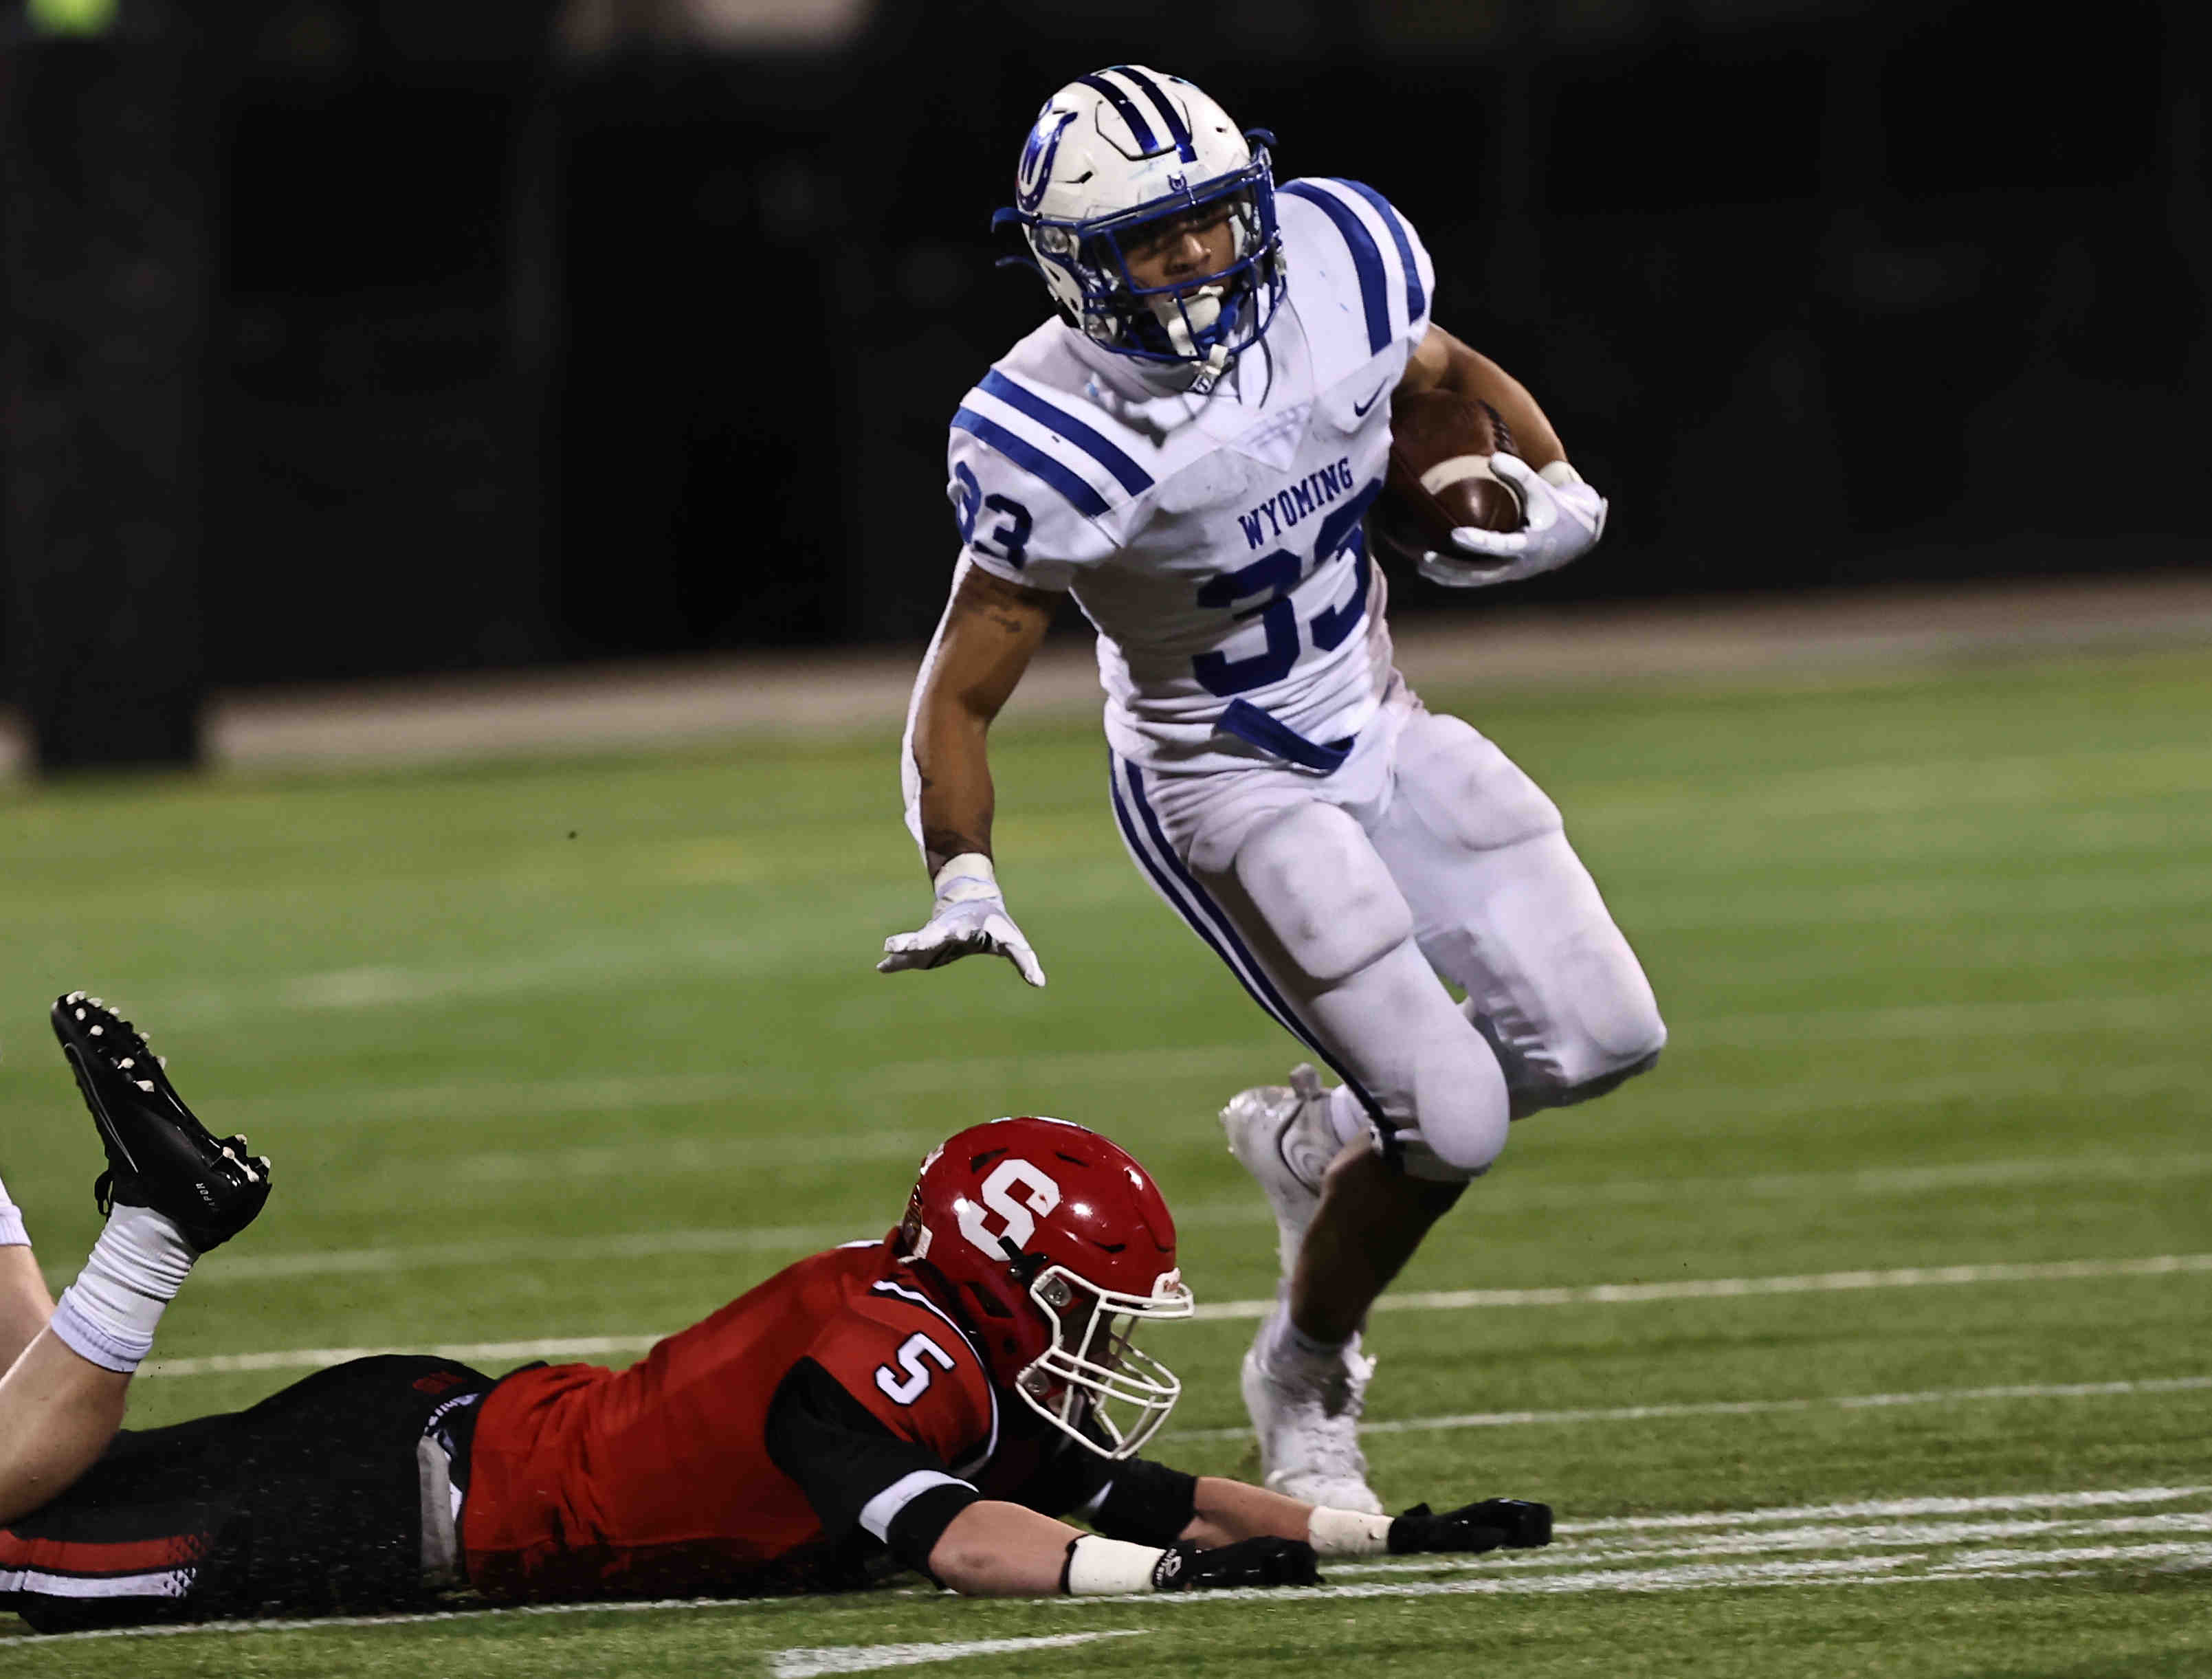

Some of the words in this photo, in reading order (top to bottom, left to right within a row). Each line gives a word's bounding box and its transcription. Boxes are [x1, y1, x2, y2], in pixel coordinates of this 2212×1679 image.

[955, 460, 1033, 570] 33
[1238, 456, 1353, 550] WYOMING
[1194, 478, 1383, 698] 33
[957, 1159, 1061, 1261] S
[874, 1332, 956, 1406] 5
